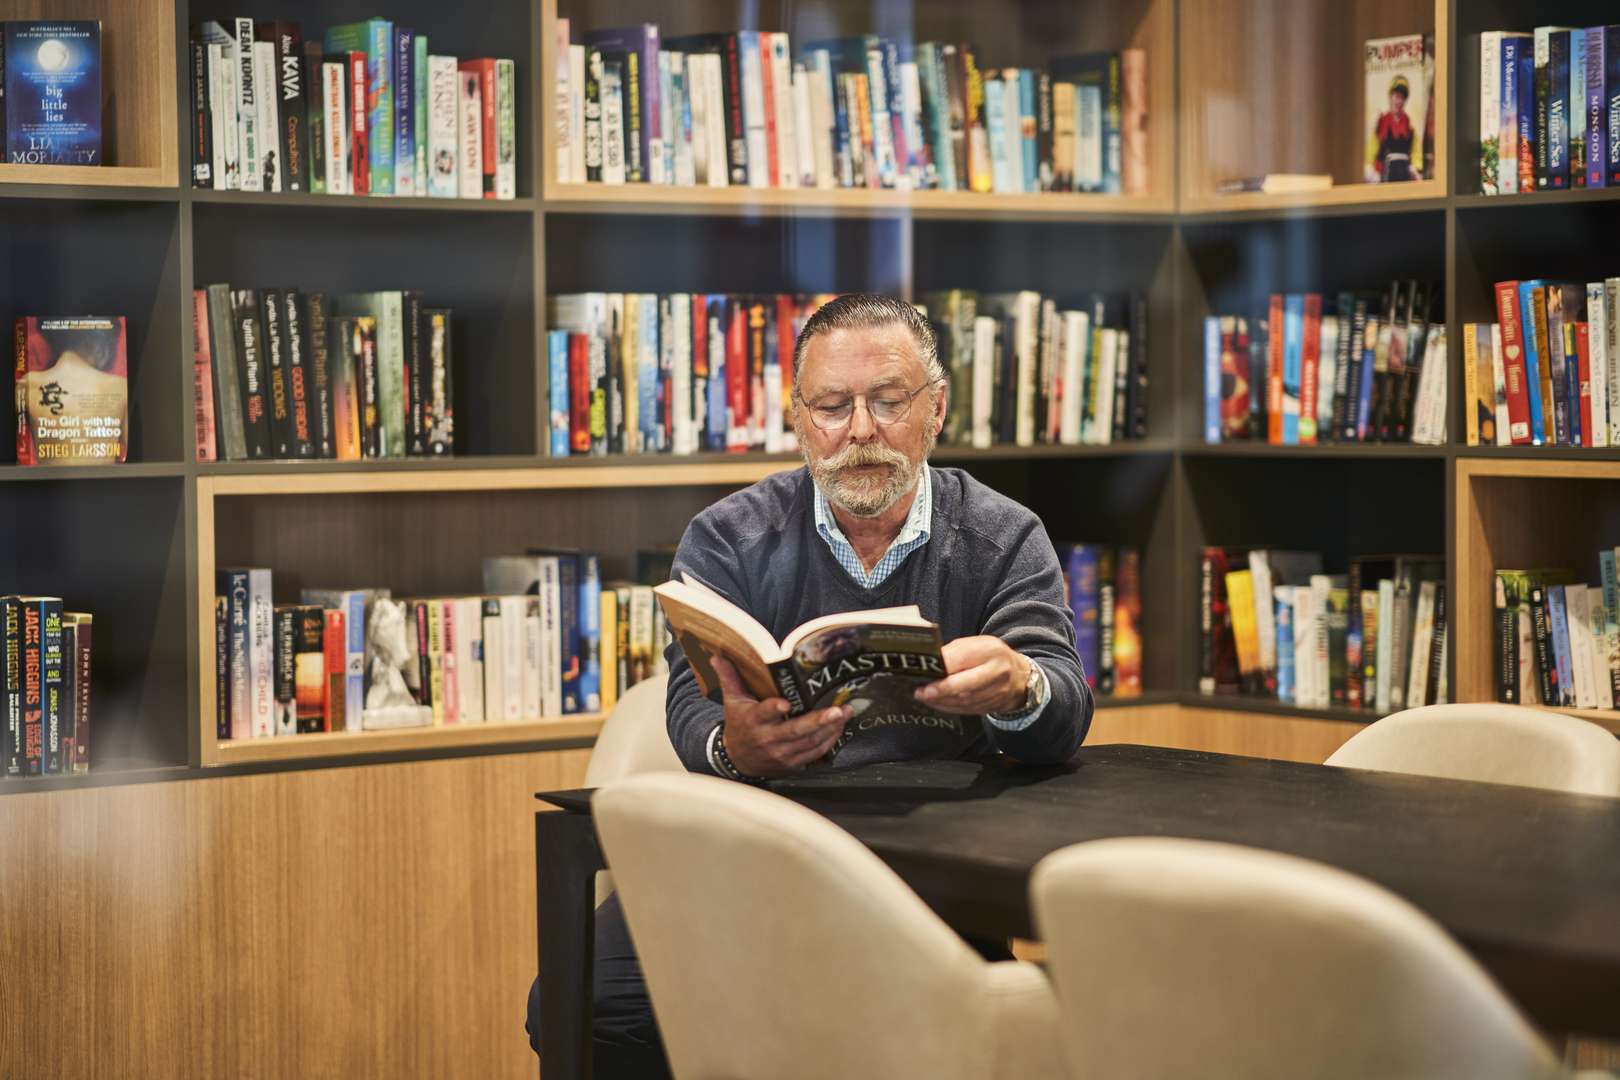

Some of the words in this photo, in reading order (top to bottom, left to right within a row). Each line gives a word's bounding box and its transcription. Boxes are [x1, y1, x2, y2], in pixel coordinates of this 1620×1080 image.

[239, 20, 252, 54] DEAN
[281, 34, 292, 55] Alex
[46, 85, 63, 98] big
[240, 57, 254, 106] KOONTZ
[281, 56, 300, 100] KAVA
[41, 99, 68, 110] little
[46, 110, 64, 122] lies
[1551, 98, 1564, 142] Winter
[1591, 95, 1600, 162] MONSOON
[1551, 144, 1564, 168] Sea
[266, 294, 277, 322] Lynda
[286, 293, 297, 321] Lynda
[242, 318, 254, 348] Lynda
[270, 322, 279, 336] La
[289, 320, 298, 335] La
[246, 348, 256, 362] La
[271, 335, 280, 366] Plante
[291, 334, 301, 365] Plante
[247, 361, 259, 393] Plante
[37, 426, 81, 440] Dragon
[85, 426, 121, 438] Tattoo
[38, 418, 56, 427] The
[59, 415, 80, 427] Girl
[82, 415, 104, 427] with
[104, 415, 121, 427] the
[38, 445, 70, 457] STIEG
[72, 443, 121, 458] LARSSON
[6, 603, 19, 636] JACK
[25, 607, 39, 645] JACK
[46, 617, 60, 627] ONE
[7, 639, 19, 690] HIGGINS
[26, 648, 40, 705] HIGGINS
[82, 648, 90, 677] JOHN
[806, 653, 944, 696] MASTER
[50, 687, 58, 713] JONAS
[50, 713, 58, 752] JONASSON
[858, 714, 954, 730] CARLYON
